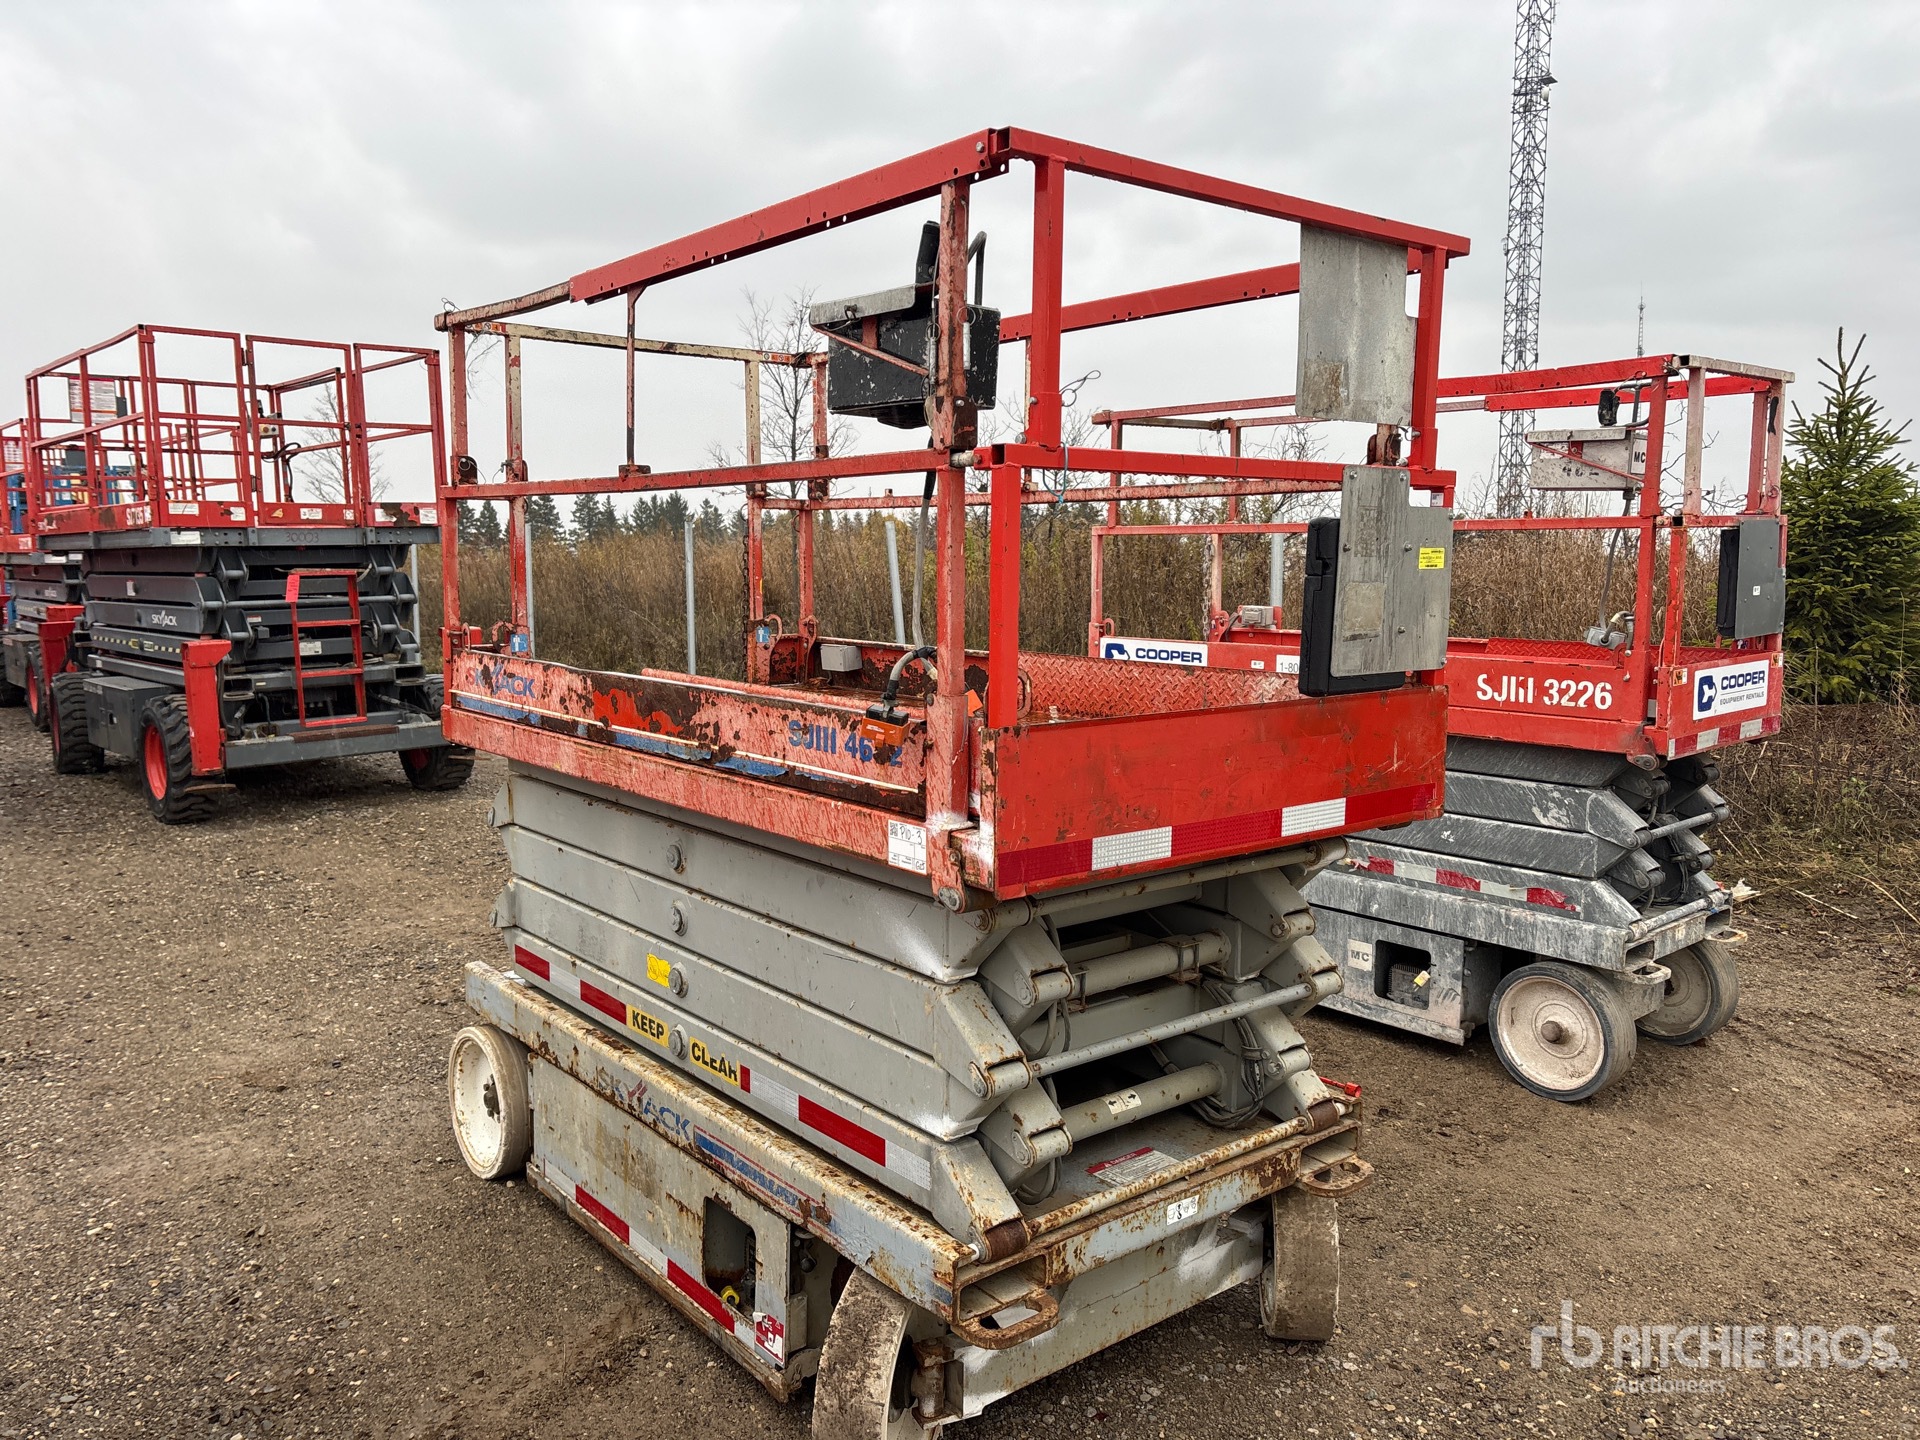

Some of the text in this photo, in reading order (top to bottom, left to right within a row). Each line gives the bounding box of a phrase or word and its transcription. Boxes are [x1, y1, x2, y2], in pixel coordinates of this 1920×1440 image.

[1634, 451, 1646, 464] MC
[284, 531, 320, 544] 30003
[151, 609, 178, 628] SKYJACK
[1135, 647, 1203, 664] COOPER
[1720, 669, 1766, 691] COOPER
[1542, 678, 1613, 711] 3226
[1719, 691, 1765, 706] EQUIPMENT RENTALS
[788, 719, 903, 768] SJIII 462
[1350, 949, 1370, 962] MC
[631, 1009, 665, 1040] KEEP
